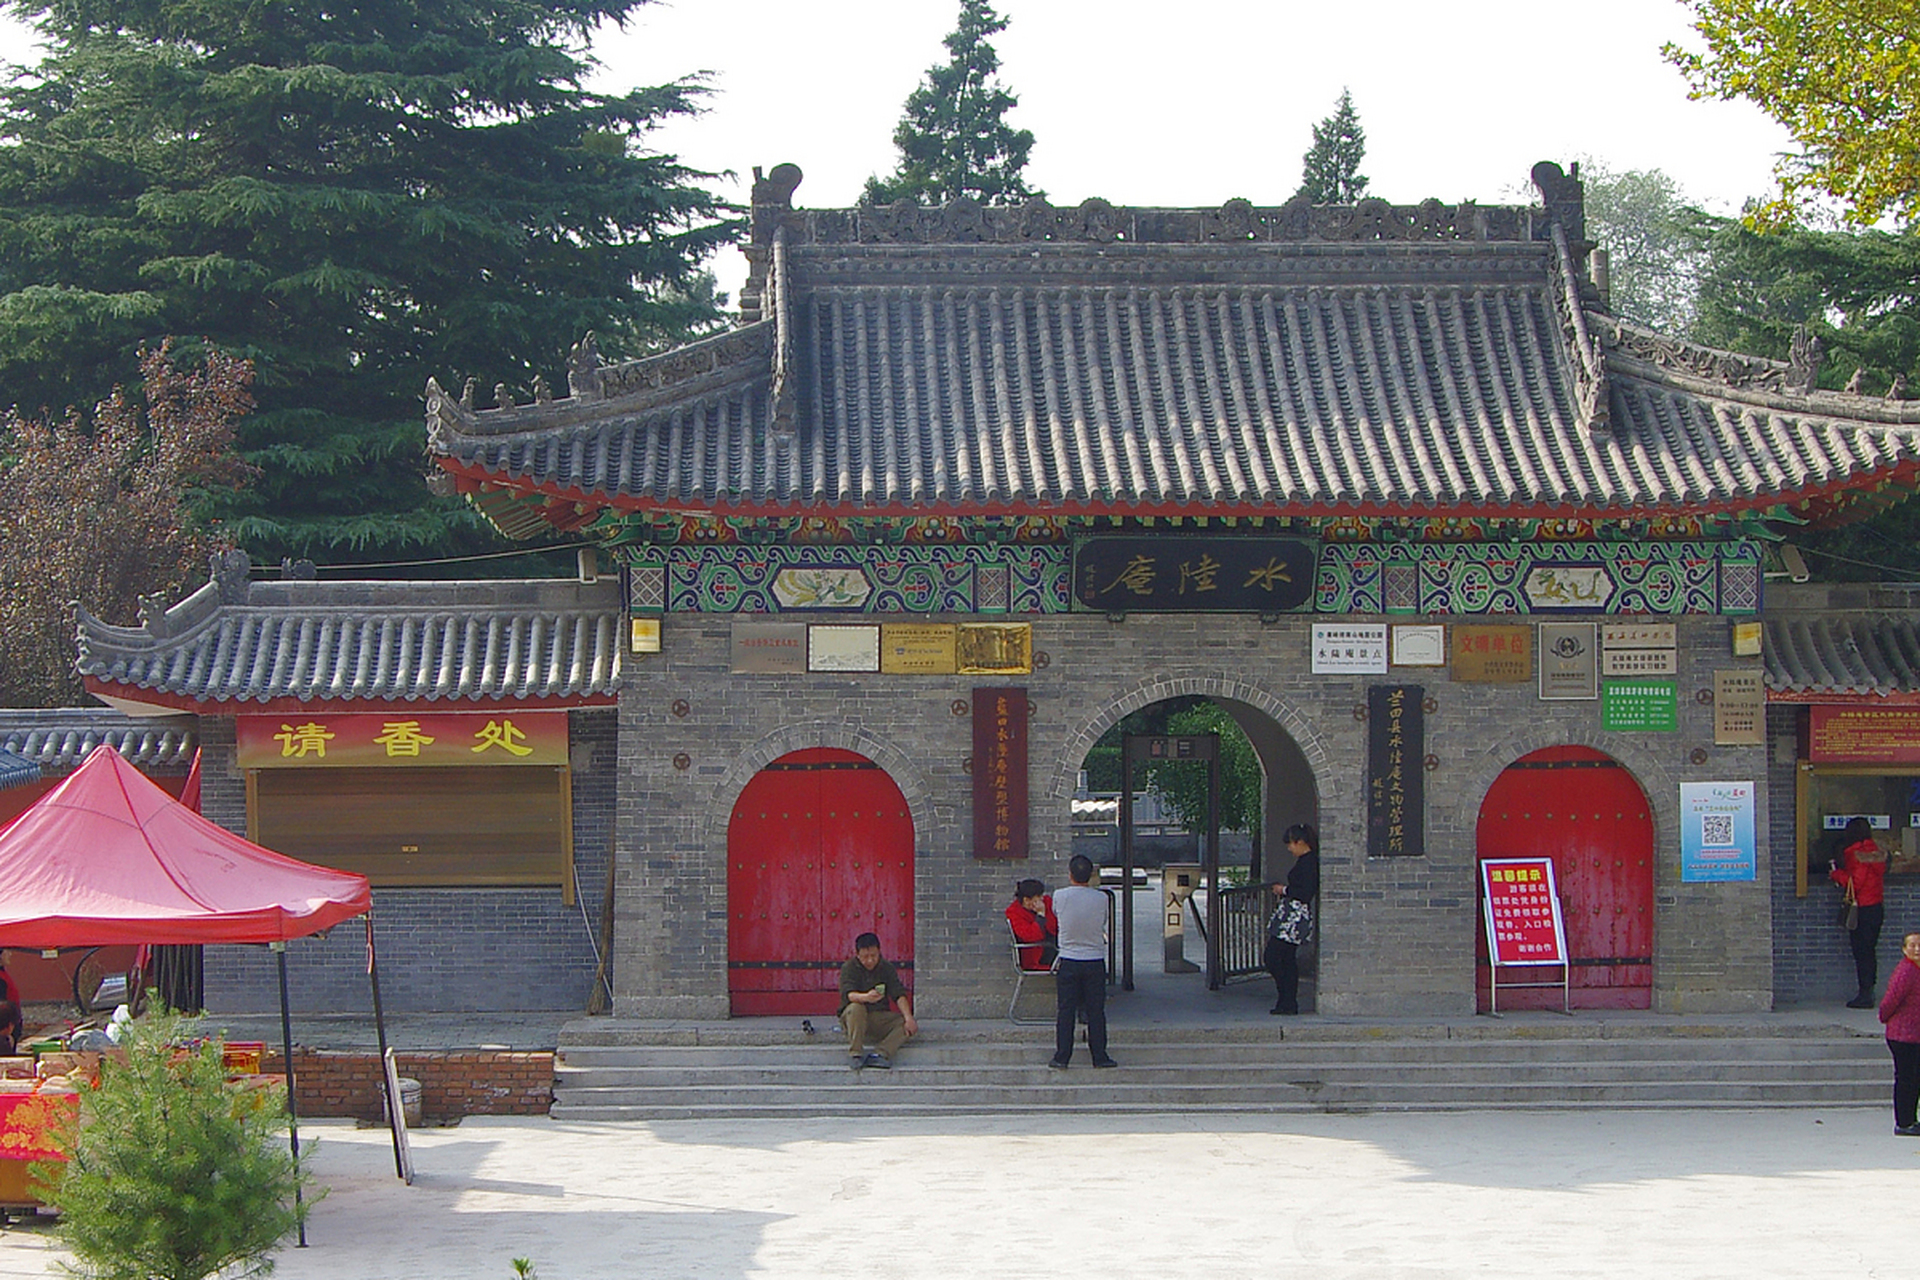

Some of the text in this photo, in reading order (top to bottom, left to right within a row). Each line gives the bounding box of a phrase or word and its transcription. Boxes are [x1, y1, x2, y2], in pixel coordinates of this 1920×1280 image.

[1461, 634, 1524, 654] 文明单位
[274, 719, 533, 758] 请香处
[1491, 869, 1541, 882] 温馨提示
[1166, 892, 1182, 926] 入口
